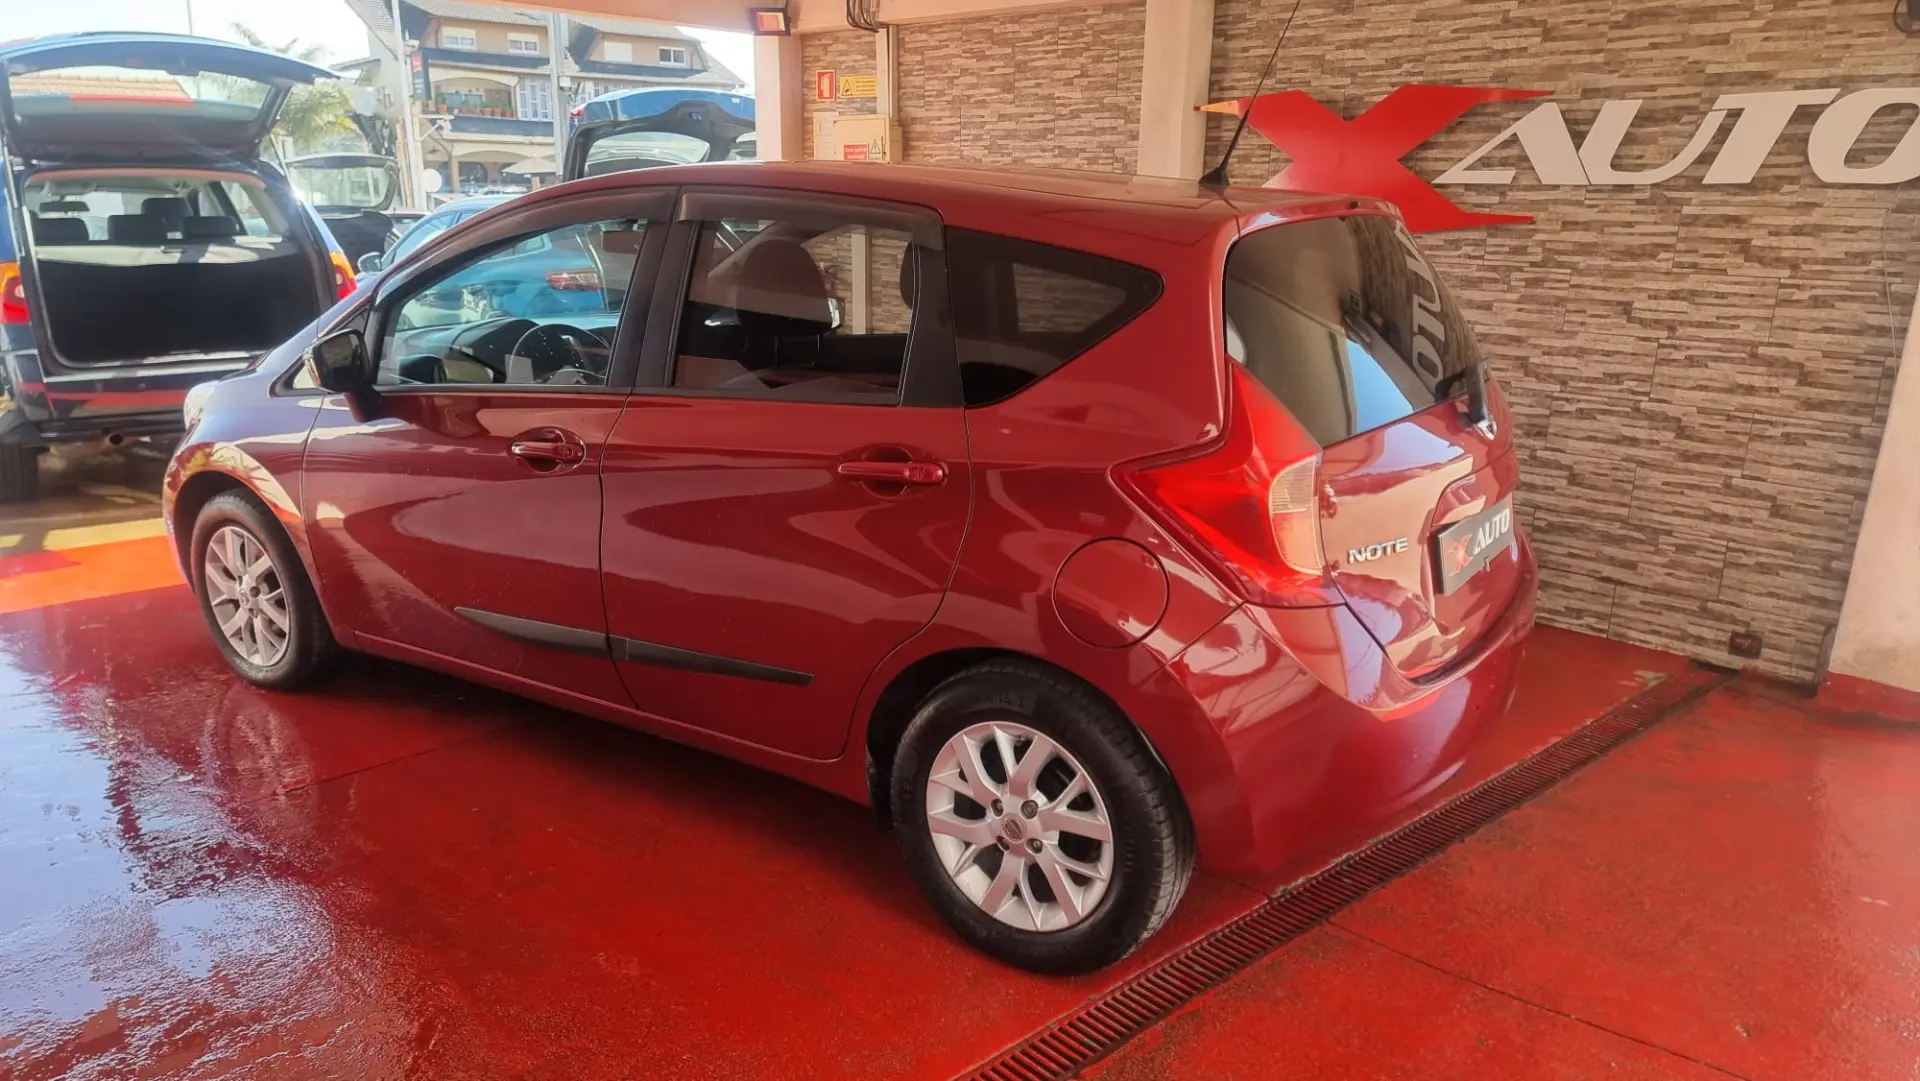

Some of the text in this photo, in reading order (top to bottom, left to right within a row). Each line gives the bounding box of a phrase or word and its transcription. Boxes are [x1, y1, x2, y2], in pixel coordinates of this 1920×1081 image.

[1193, 83, 1920, 232] X AUTO
[1348, 537, 1408, 564] NOTE
[1446, 508, 1510, 577] X AUTO
